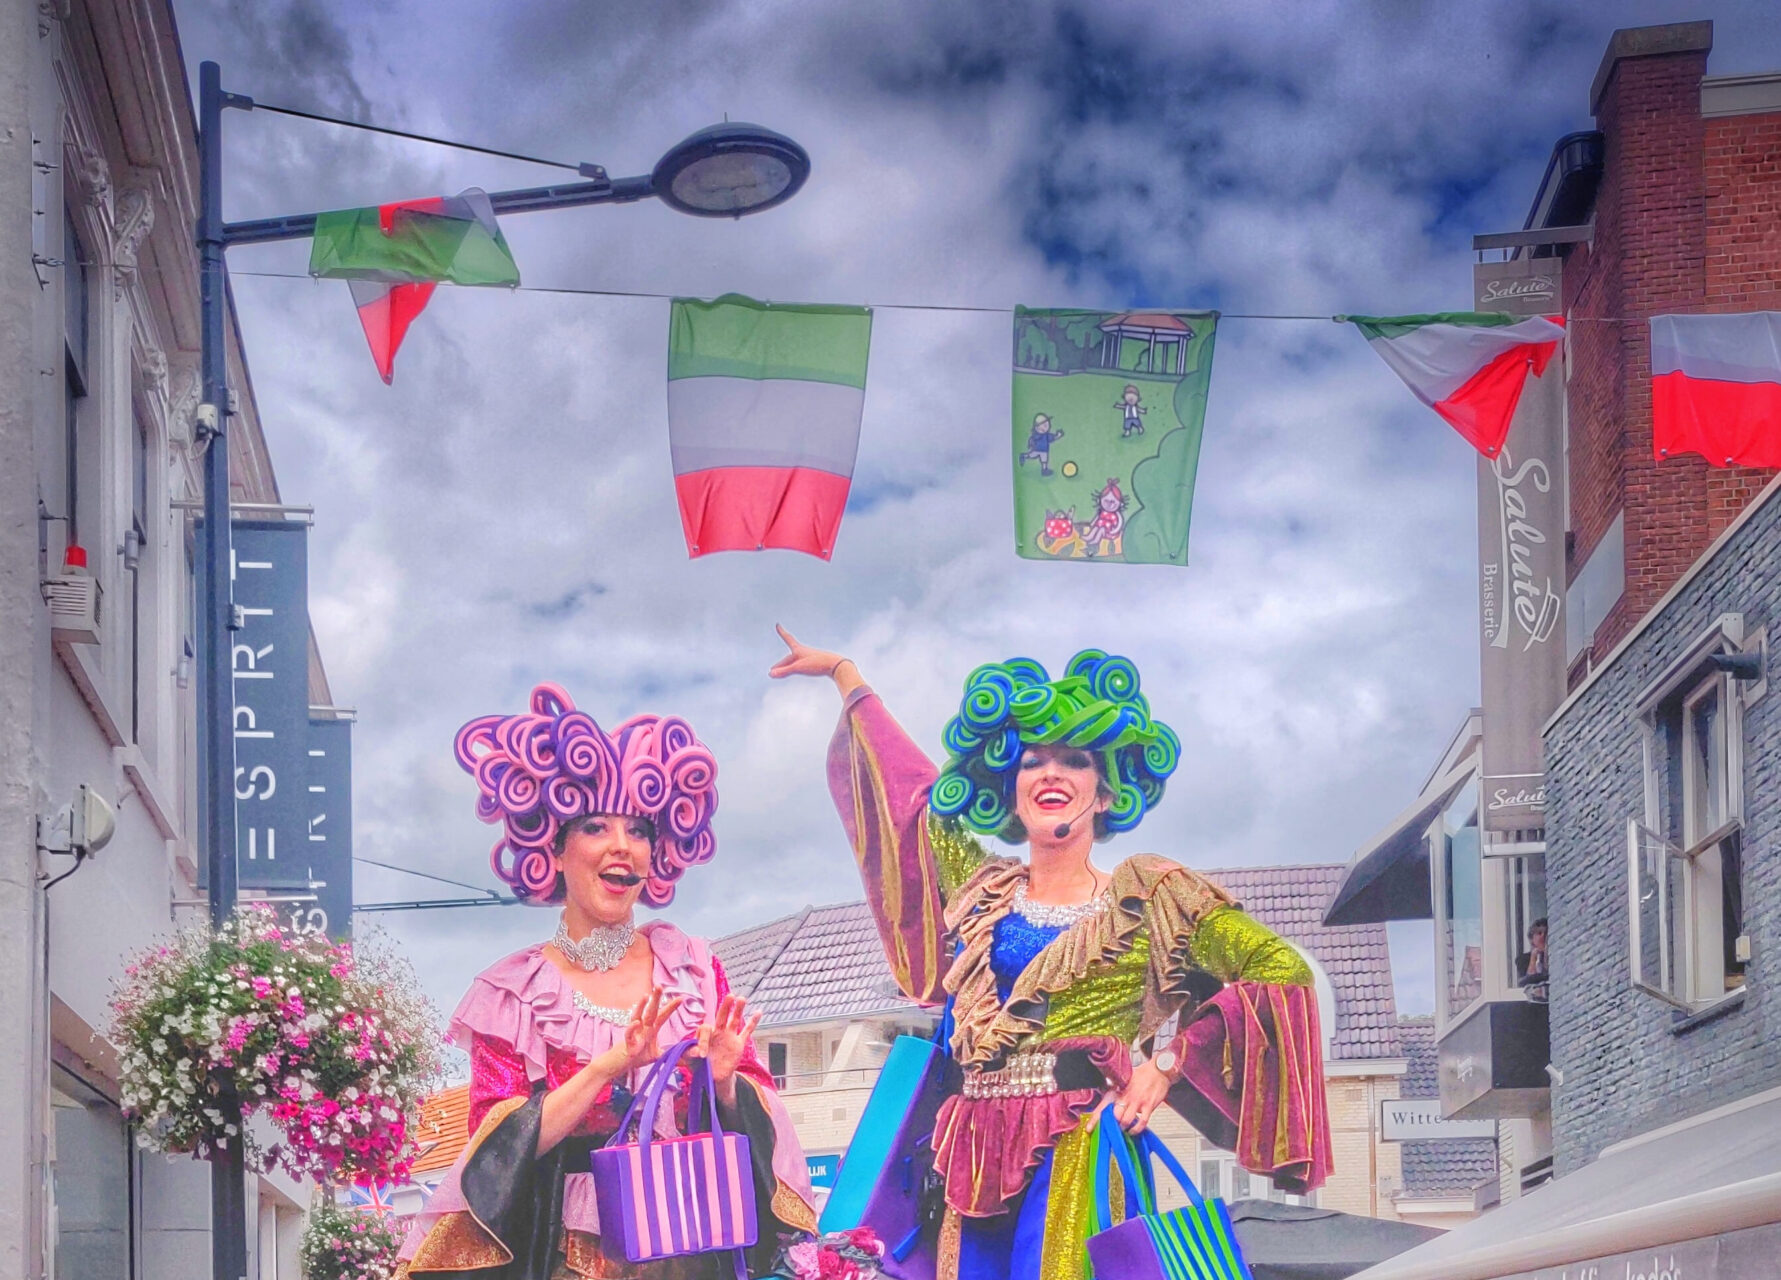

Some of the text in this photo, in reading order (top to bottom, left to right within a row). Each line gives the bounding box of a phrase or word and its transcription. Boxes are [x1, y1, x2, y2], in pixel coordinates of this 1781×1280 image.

[1491, 444, 1554, 650] Salute
[1483, 563, 1498, 638] Brasserie
[1488, 786, 1545, 810] Salut
